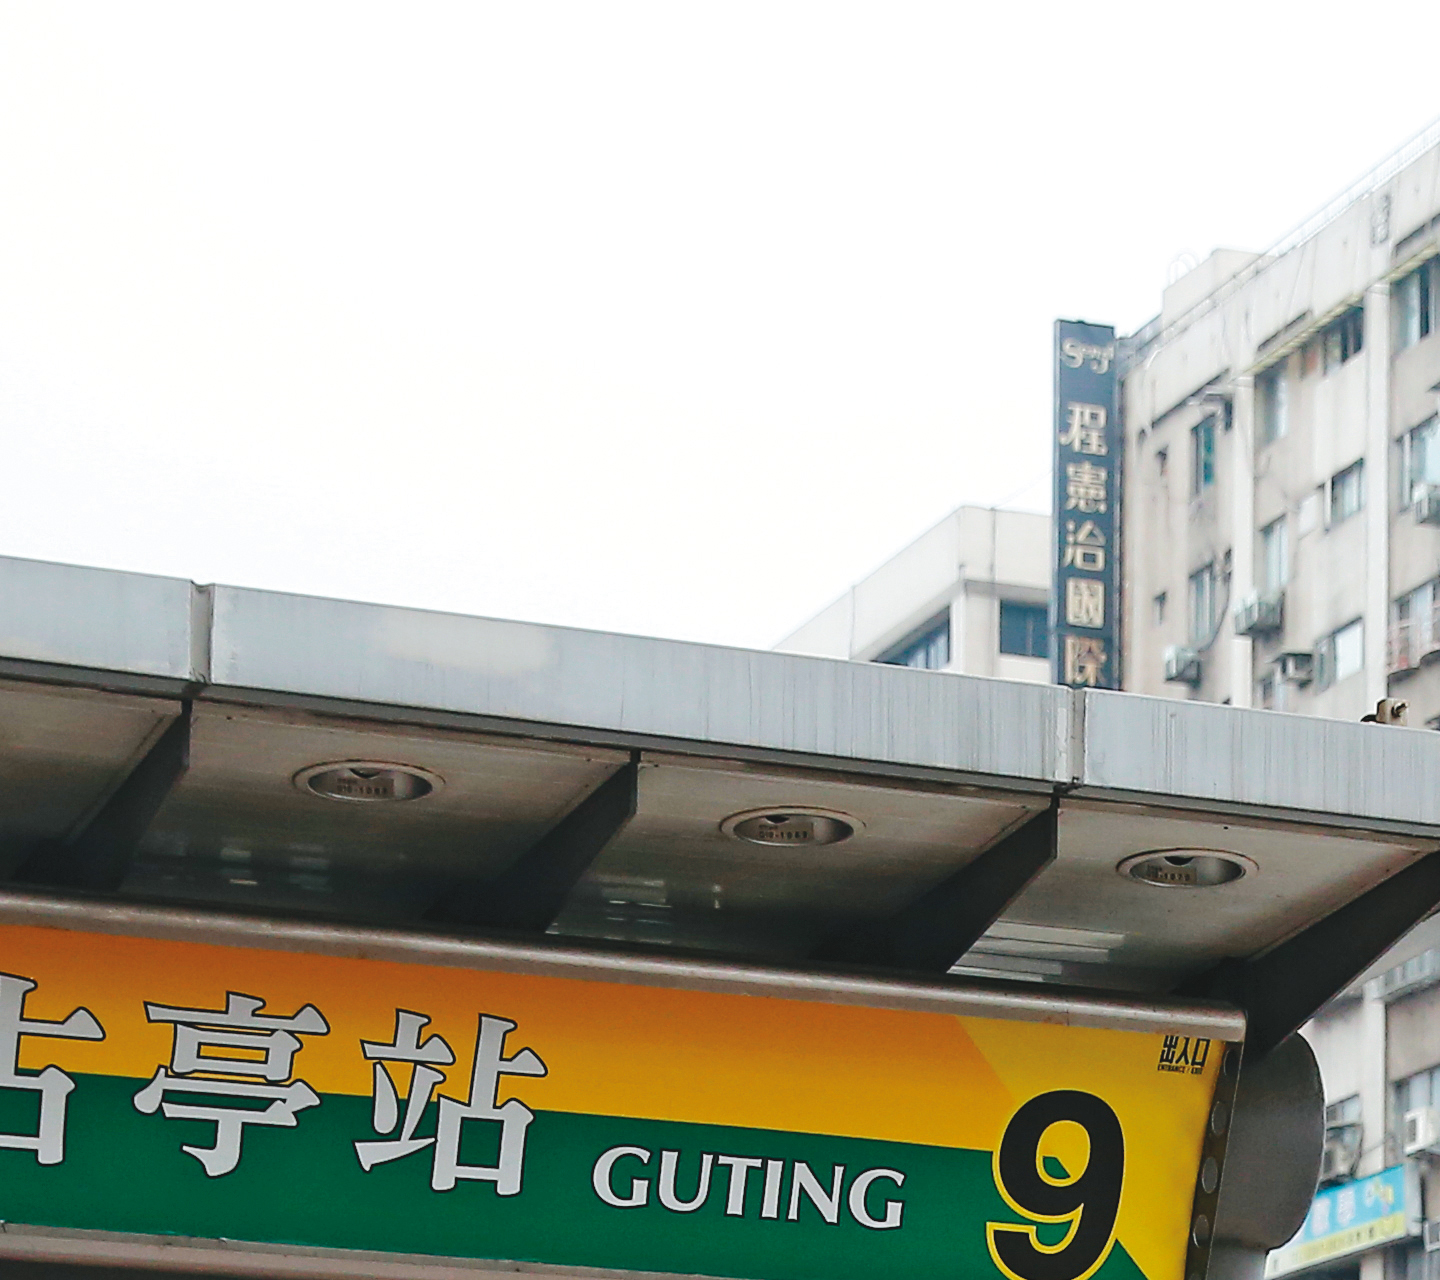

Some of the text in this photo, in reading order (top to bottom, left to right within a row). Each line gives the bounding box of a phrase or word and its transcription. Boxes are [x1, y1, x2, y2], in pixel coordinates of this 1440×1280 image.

[1159, 1034, 1211, 1067] 出入口
[591, 1144, 906, 1230] GUTING
